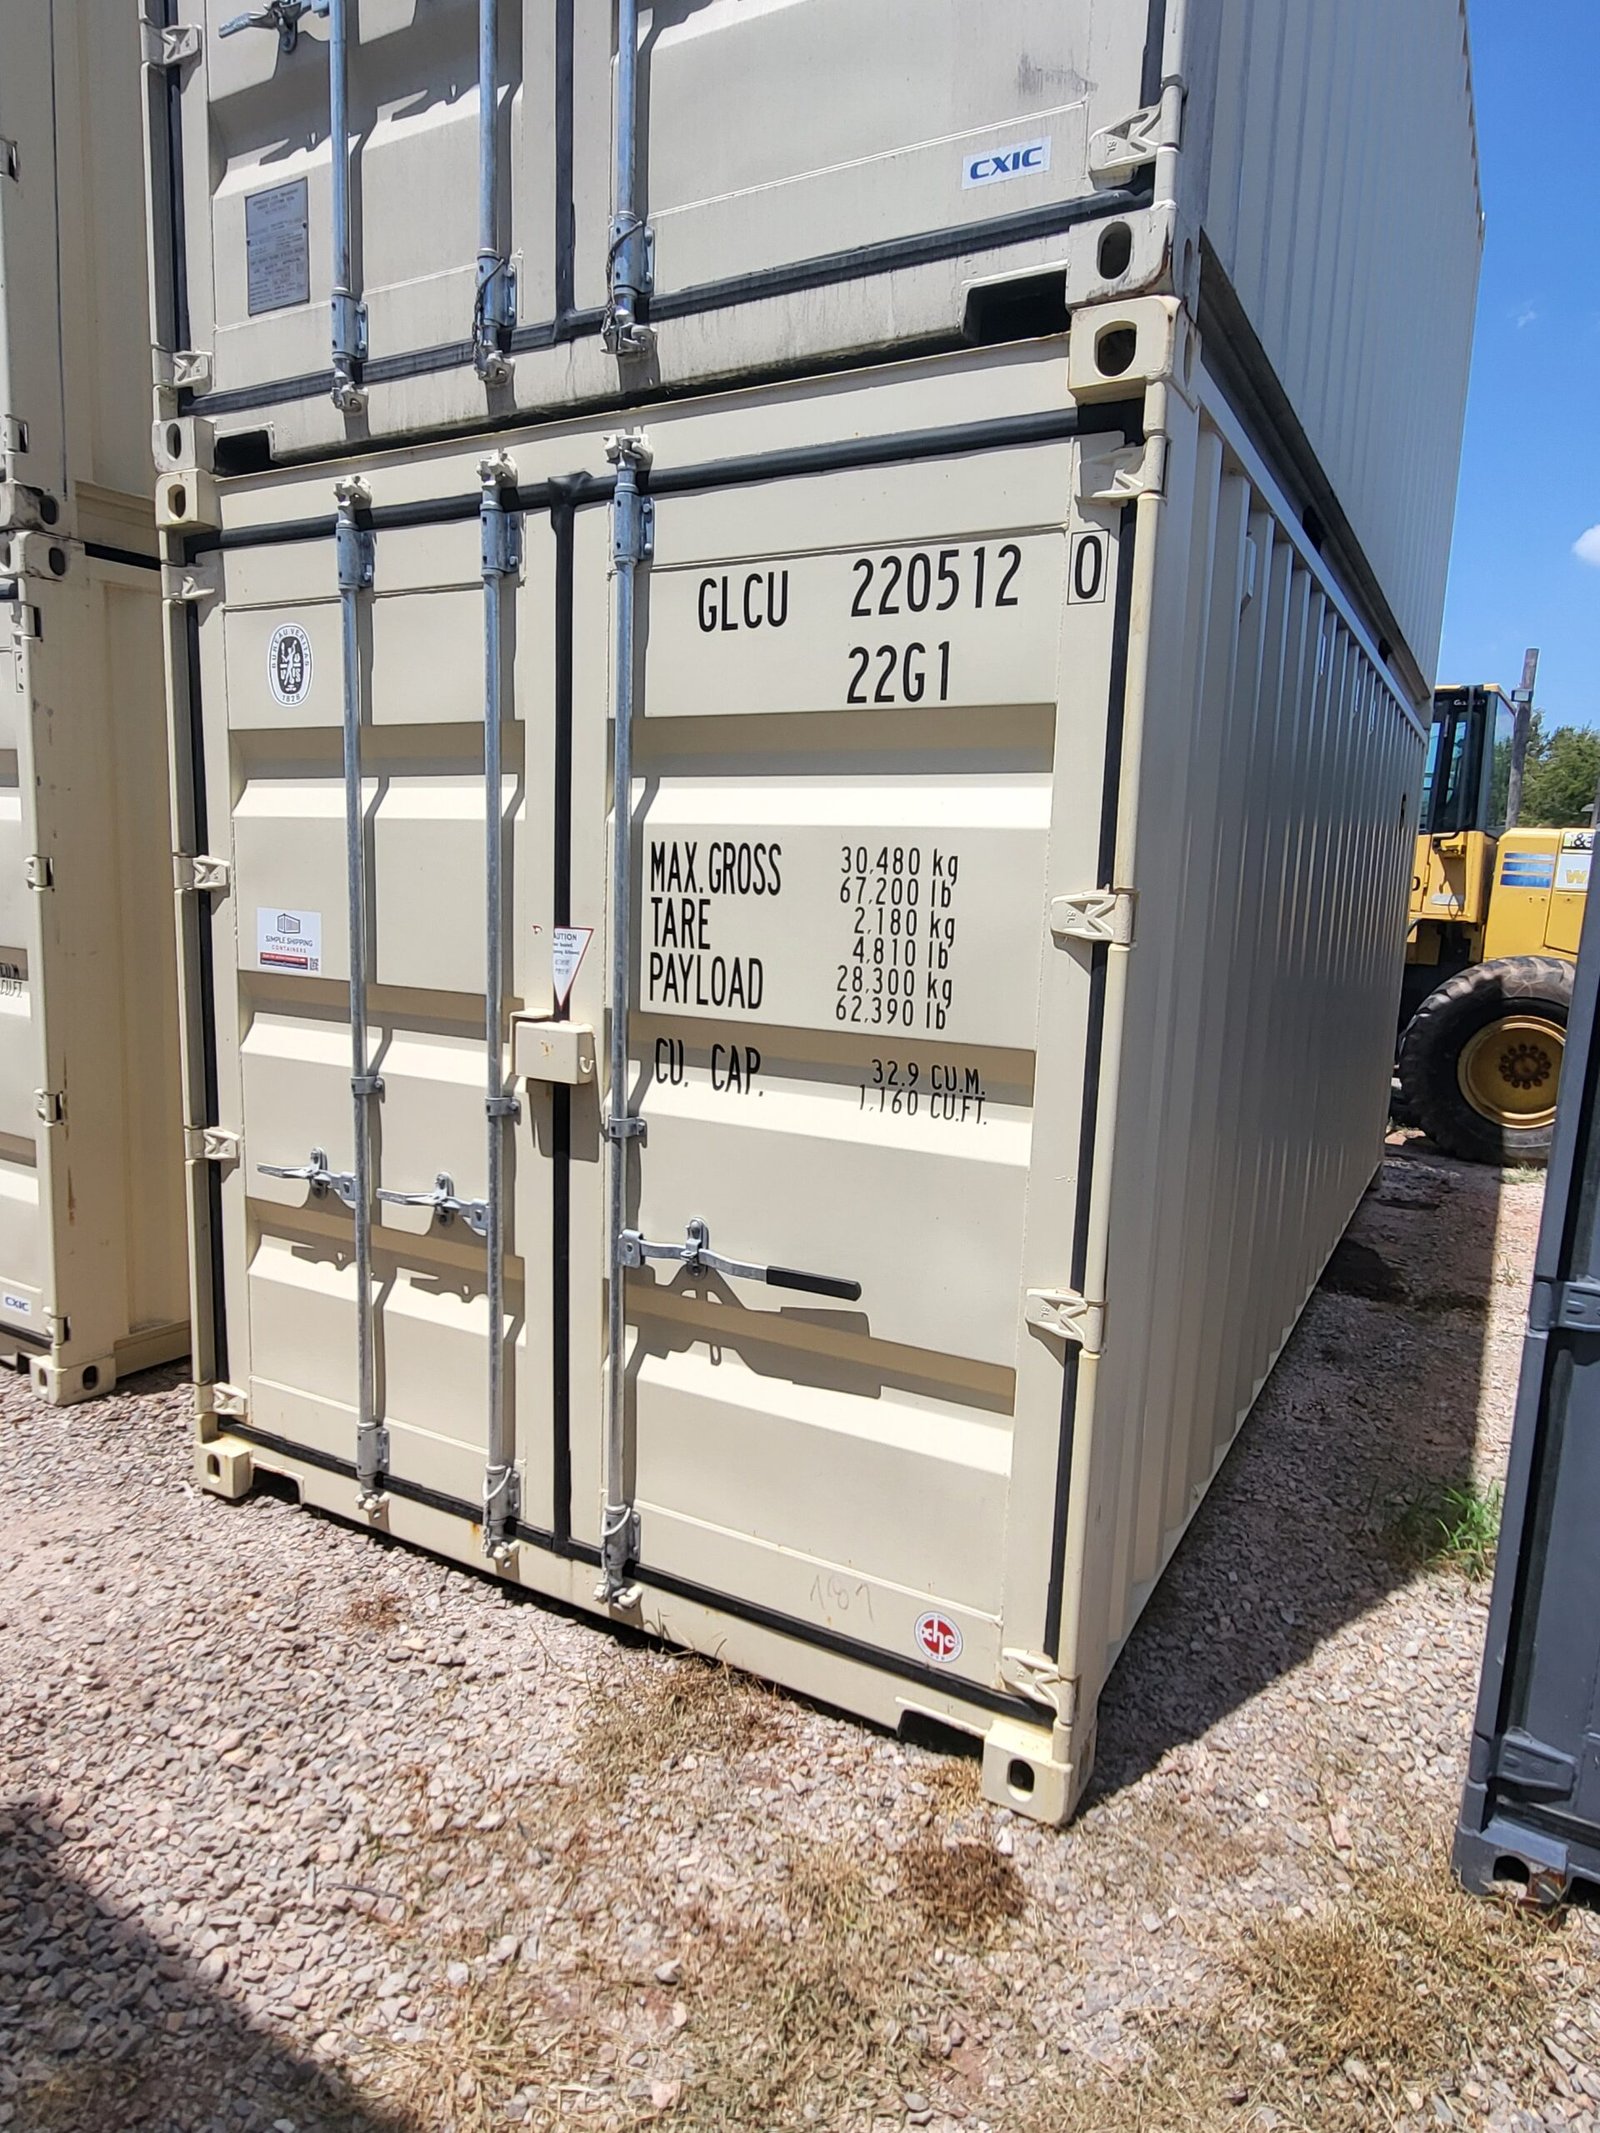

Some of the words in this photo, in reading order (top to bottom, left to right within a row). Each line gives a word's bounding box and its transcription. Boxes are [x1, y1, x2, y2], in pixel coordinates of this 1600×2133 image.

[970, 146, 1043, 180] CXIC
[698, 569, 790, 633] GLCU
[850, 544, 1022, 617] 220512
[1074, 535, 1102, 600] 0
[846, 641, 951, 704] 22G1
[841, 846, 920, 876] 30,480
[932, 848, 959, 886] kg
[840, 876, 919, 906] 67,200
[931, 879, 952, 908] lb
[265, 935, 286, 944] SIMPLE
[287, 937, 313, 947] SHIPPING
[651, 897, 711, 950] TARE
[854, 906, 918, 937] 2,180
[930, 910, 956, 948] kg
[852, 936, 916, 966] 4,810
[928, 940, 949, 969] lb
[650, 952, 764, 1010] PAYLOAD
[837, 965, 915, 996] 28,300
[927, 971, 953, 1009] kg
[835, 995, 914, 1027] 62,390
[925, 1001, 946, 1030] lb
[655, 1038, 689, 1087] CU.
[711, 1043, 764, 1097] CAP.
[872, 1059, 920, 1087] 32.9
[931, 1065, 986, 1095] CU.M.
[859, 1084, 919, 1116] 1,160
[930, 1092, 988, 1126] CU.FT.
[5, 1296, 29, 1312] CXIC
